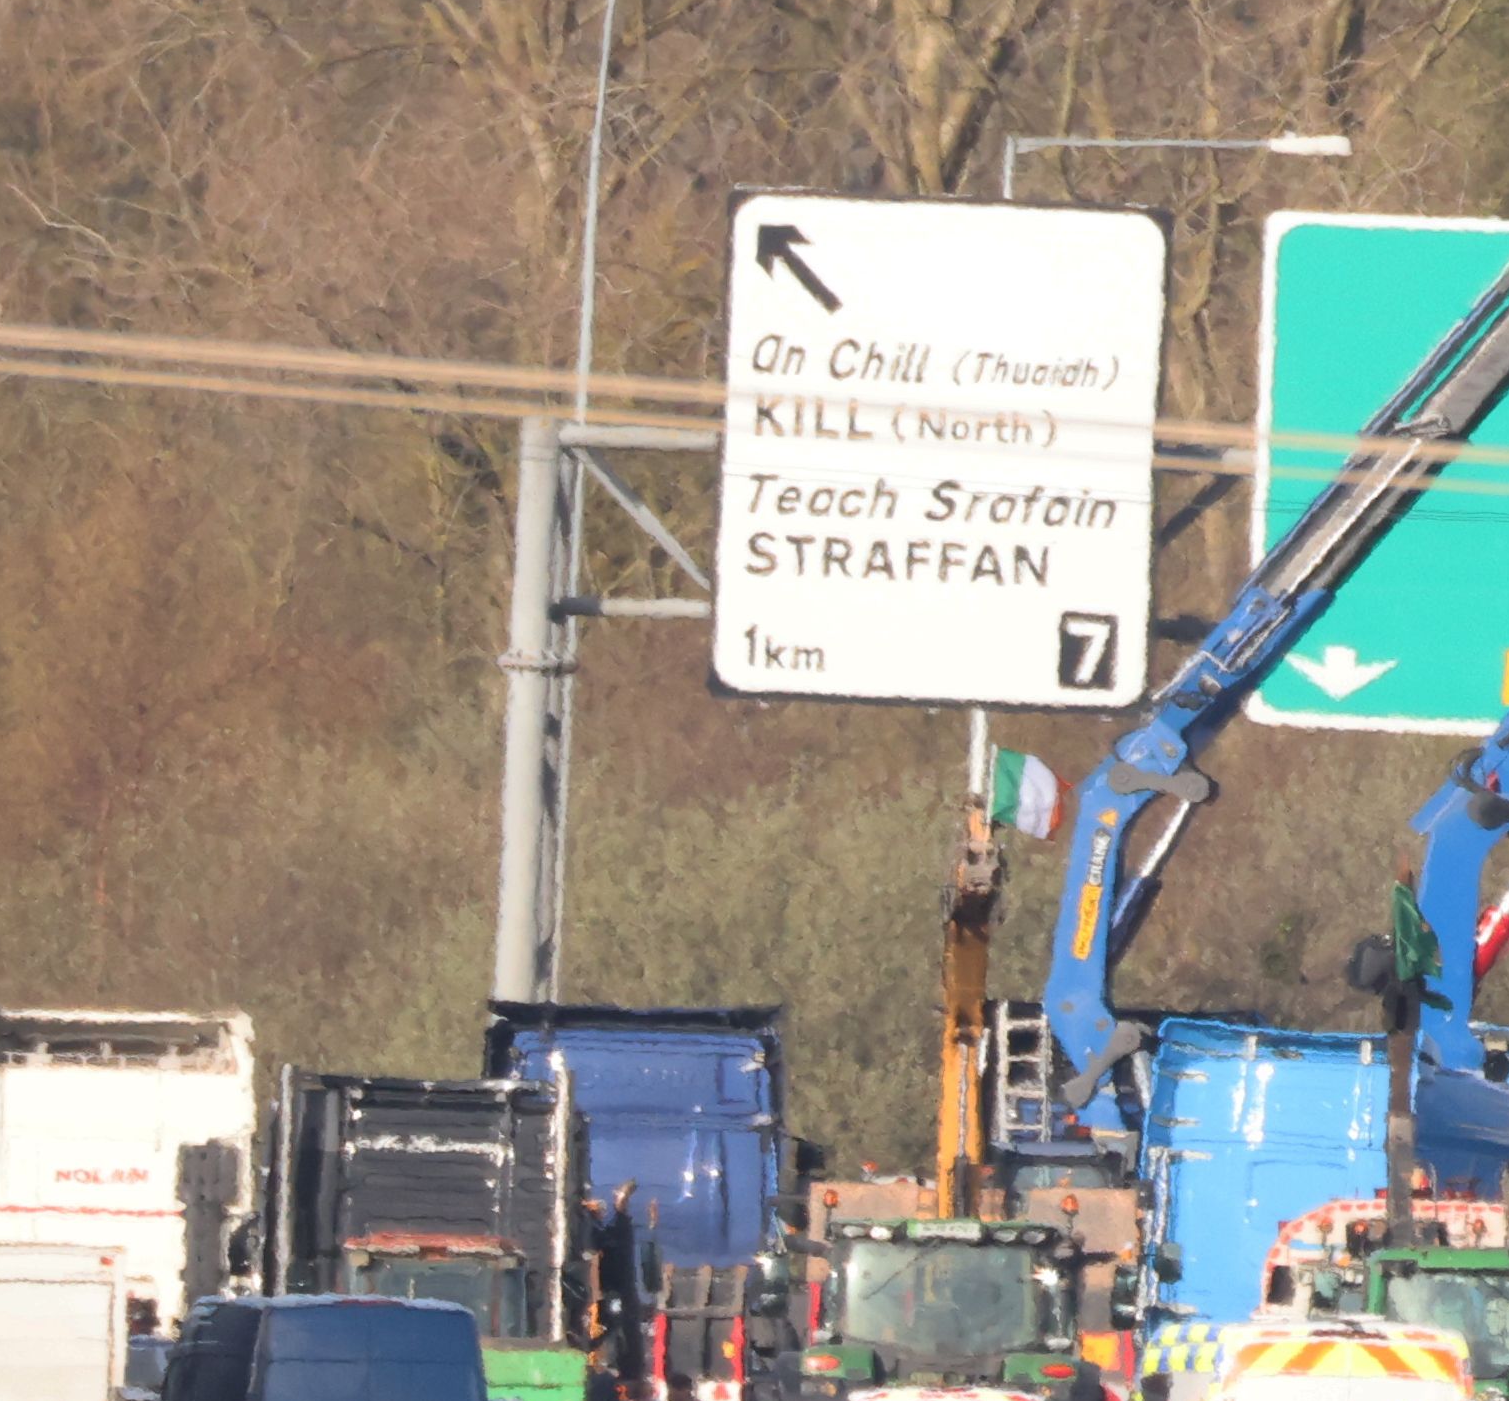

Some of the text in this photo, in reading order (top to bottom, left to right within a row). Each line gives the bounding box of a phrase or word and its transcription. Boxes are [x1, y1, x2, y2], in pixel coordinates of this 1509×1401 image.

[828, 338, 931, 385] Chill
[952, 351, 1121, 391] (Thuaidh)
[754, 395, 1058, 448] KILL (North)
[748, 474, 899, 520] Teach
[745, 532, 1051, 588] STRAFFAN
[1069, 618, 1112, 686] 7
